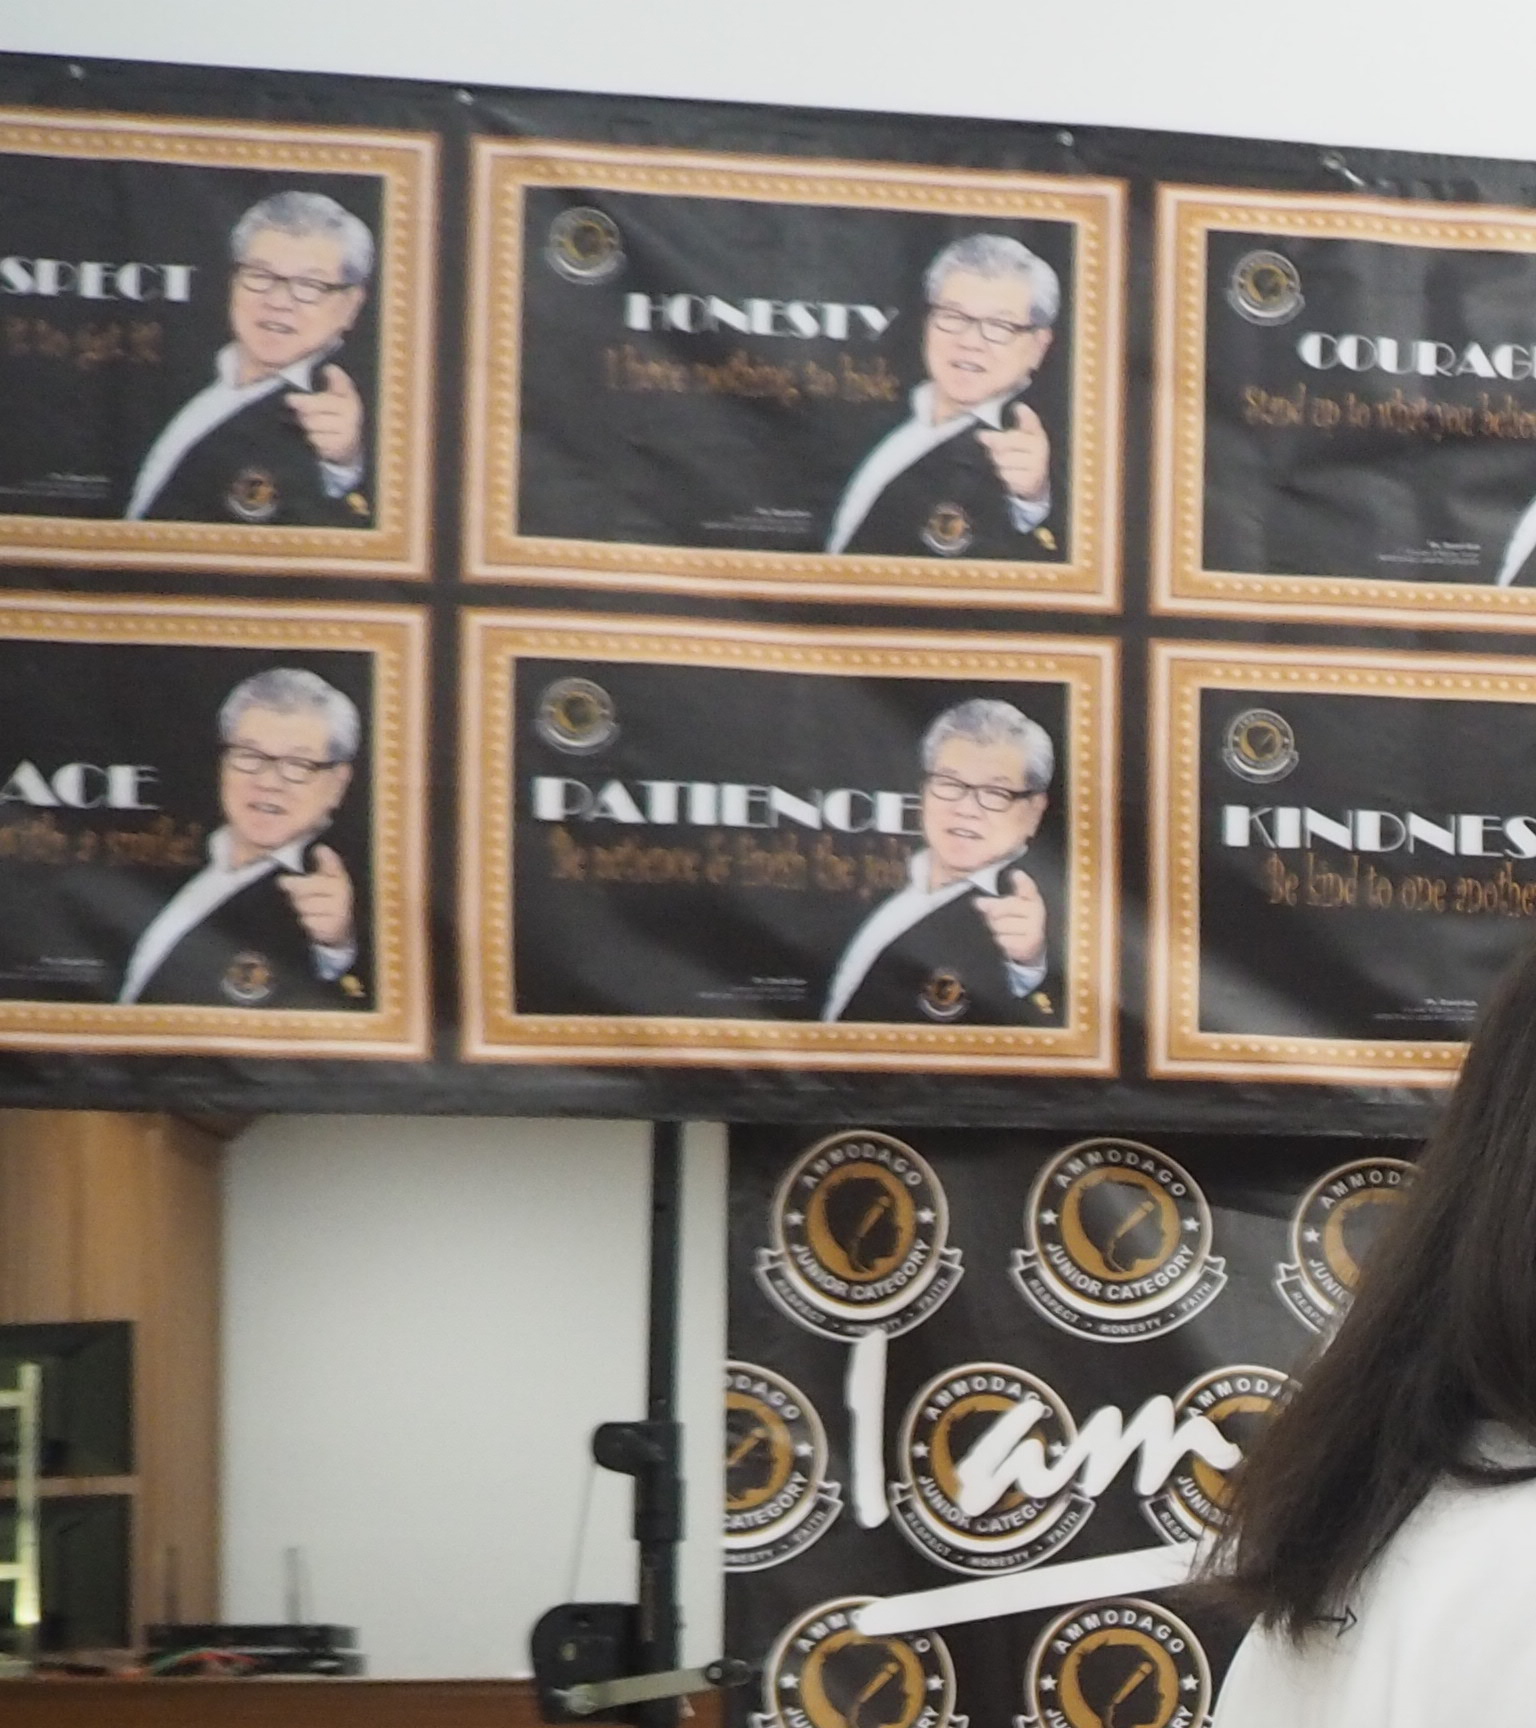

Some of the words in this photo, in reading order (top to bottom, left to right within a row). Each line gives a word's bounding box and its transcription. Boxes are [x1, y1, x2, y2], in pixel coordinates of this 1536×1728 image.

[625, 292, 899, 340] HONESTY
[531, 776, 923, 836] PATIENCE
[802, 1143, 922, 1189] AMMODAGO
[1054, 1149, 1187, 1197] AMMODAGO
[1320, 1170, 1408, 1209] AMMOD
[792, 1244, 849, 1297] JUNIOR
[850, 1239, 931, 1300] CATEGORY
[1046, 1242, 1103, 1296] JUNIOR
[1106, 1243, 1195, 1300] CATEGORY
[1309, 1258, 1348, 1300] JUNI
[1185, 1377, 1282, 1419] AMMOD
[1053, 1609, 1185, 1654] AMMODAGO
